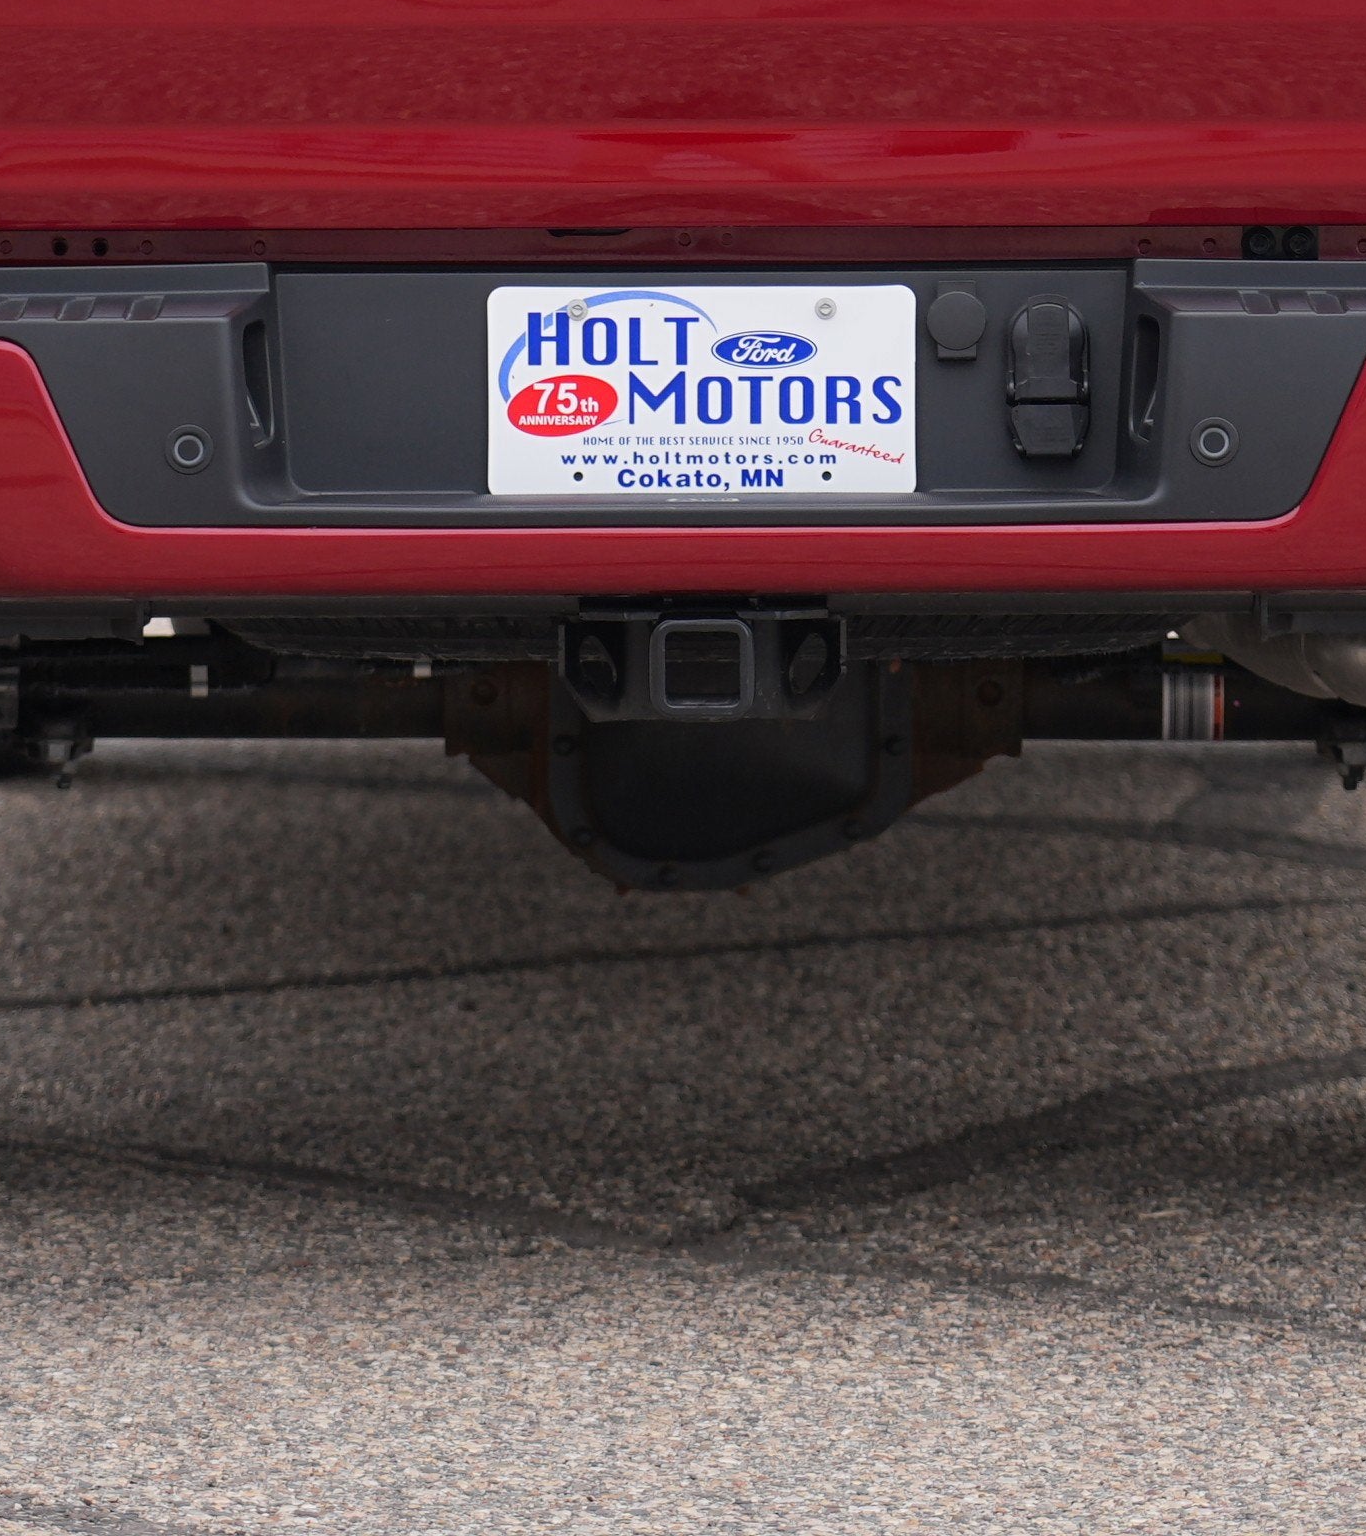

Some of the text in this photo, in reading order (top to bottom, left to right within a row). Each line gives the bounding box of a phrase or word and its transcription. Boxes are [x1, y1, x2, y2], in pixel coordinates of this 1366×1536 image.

[527, 312, 700, 366] HOLT
[732, 335, 797, 364] Ford
[533, 382, 600, 415] 75th
[629, 370, 903, 425] MOTORS
[518, 415, 599, 426] ANNIVERSARY
[583, 436, 804, 446] HOME OF THE BEST SERVICE SINCE 1950
[808, 428, 906, 464] Guaranteed
[561, 451, 836, 465] www.holtmotors.com
[617, 468, 784, 492] Cokato, MN
